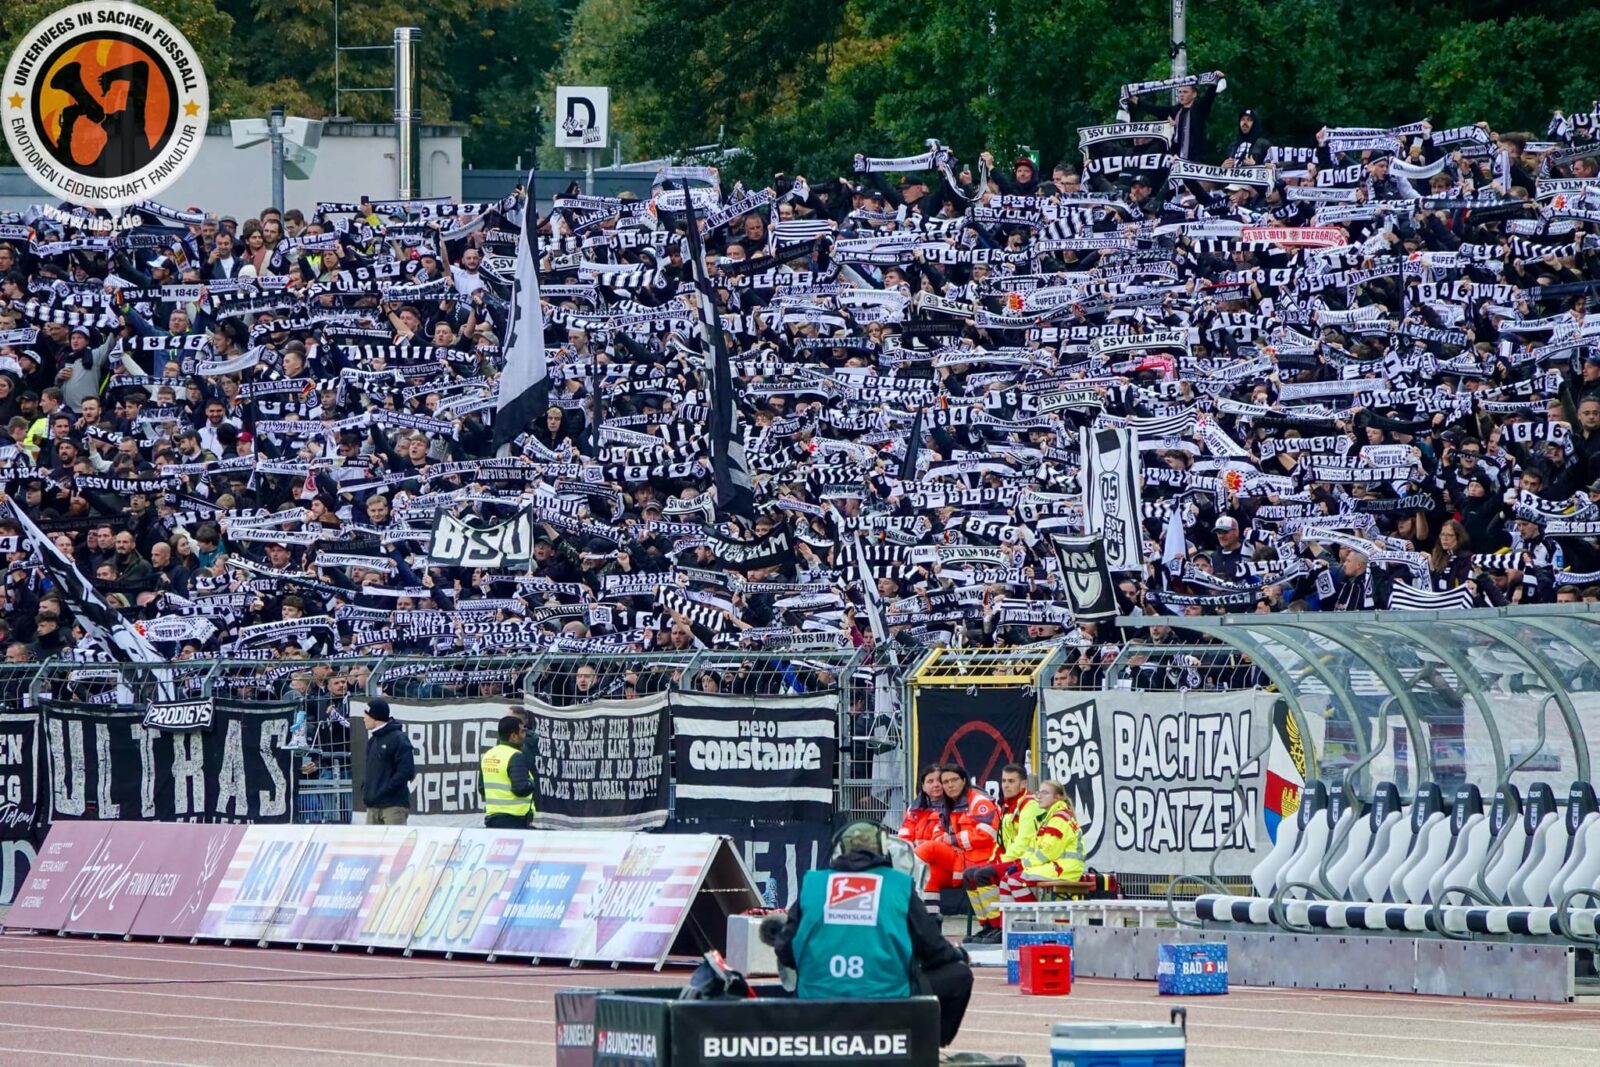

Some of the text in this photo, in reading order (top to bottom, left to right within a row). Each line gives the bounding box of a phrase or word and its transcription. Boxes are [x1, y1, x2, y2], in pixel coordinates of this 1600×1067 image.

[566, 97, 596, 137] D
[1087, 124, 1150, 139] SSV ULM 1846
[1183, 163, 1253, 179] SSV ULM 1846
[1540, 181, 1580, 194] SSV ULM
[973, 208, 1041, 223] SSV ULM
[494, 260, 514, 269] SSV
[123, 288, 198, 299] SSV ULM 1846
[337, 280, 372, 291] ULM
[942, 301, 964, 312] SSV
[250, 324, 274, 338] SSV
[1103, 332, 1180, 347] SSV ULM 1846
[447, 350, 475, 364] SSV
[275, 382, 292, 392] 1846
[634, 378, 665, 389] ULM
[1065, 392, 1086, 403] ULM
[1502, 423, 1562, 441] 1846
[1207, 434, 1227, 456] SUPER
[86, 477, 168, 493] SSV ULM 1846
[1397, 492, 1435, 511] PROUD
[1104, 516, 1124, 533] SSV
[1104, 529, 1125, 544] 1846
[939, 549, 1001, 561] SSV ULM 1846
[930, 594, 946, 605] SSV
[949, 592, 967, 602] ULM
[148, 703, 212, 724] PRODIGYS
[552, 719, 571, 740] ZIEL
[573, 720, 589, 741] DAS
[608, 717, 629, 739] EINE
[738, 719, 777, 738] nero
[1046, 705, 1094, 753] SSV
[568, 738, 605, 760] MINUTEN
[607, 738, 630, 759] LANG
[1113, 710, 1260, 781] BACHTAL
[688, 738, 822, 771] constante
[1047, 740, 1100, 786] 1846
[50, 718, 289, 818] ULTRAS
[561, 760, 597, 780] MINUTEN
[599, 759, 613, 780] AM
[616, 759, 634, 780] RAD
[1114, 787, 1257, 853] SPATZEN
[126, 872, 181, 897] FINNINGEN
[526, 868, 571, 890] Shop unter
[858, 895, 873, 908] 2
[828, 913, 873, 921] BUNDESLIGA
[830, 955, 864, 978] 08
[1182, 962, 1203, 975] BAD
[564, 1024, 595, 1047] BUNDESLIGA
[606, 1032, 657, 1057] BUNDESLIGA
[704, 1034, 907, 1058] BUNDESLIGA.DE
